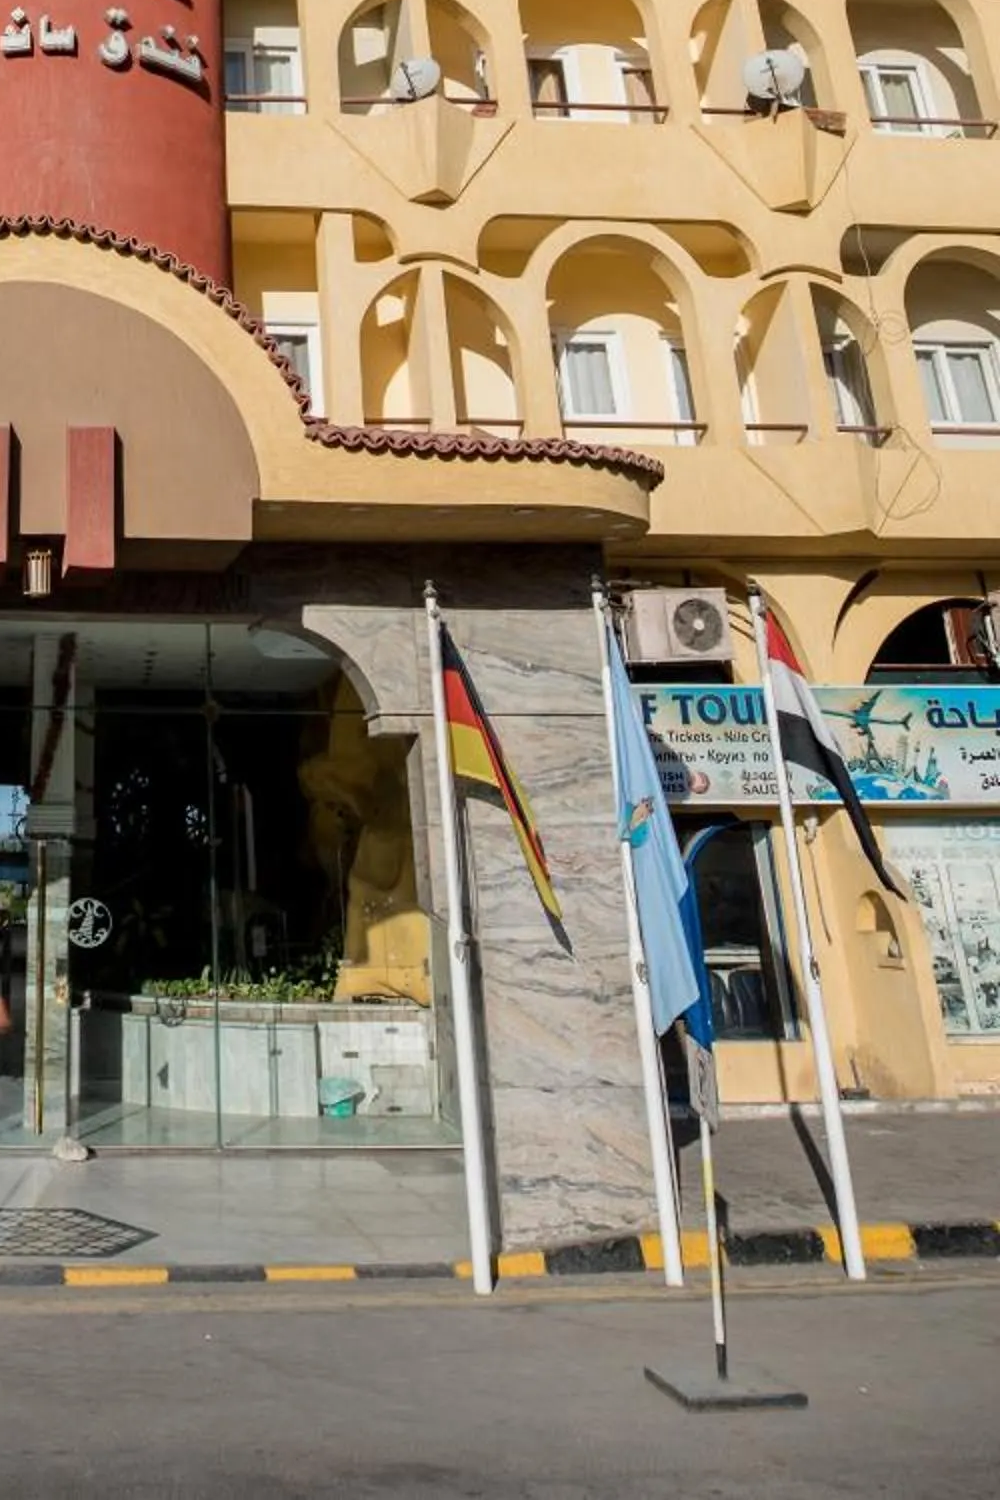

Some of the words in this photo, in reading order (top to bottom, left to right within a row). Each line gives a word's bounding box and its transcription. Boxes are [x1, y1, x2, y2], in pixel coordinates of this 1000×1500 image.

[1, 6, 76, 56] ساند
[99, 7, 204, 83] فندق
[672, 694, 767, 725] TOU
[667, 731, 713, 743] Tickets
[724, 731, 749, 743] Nile
